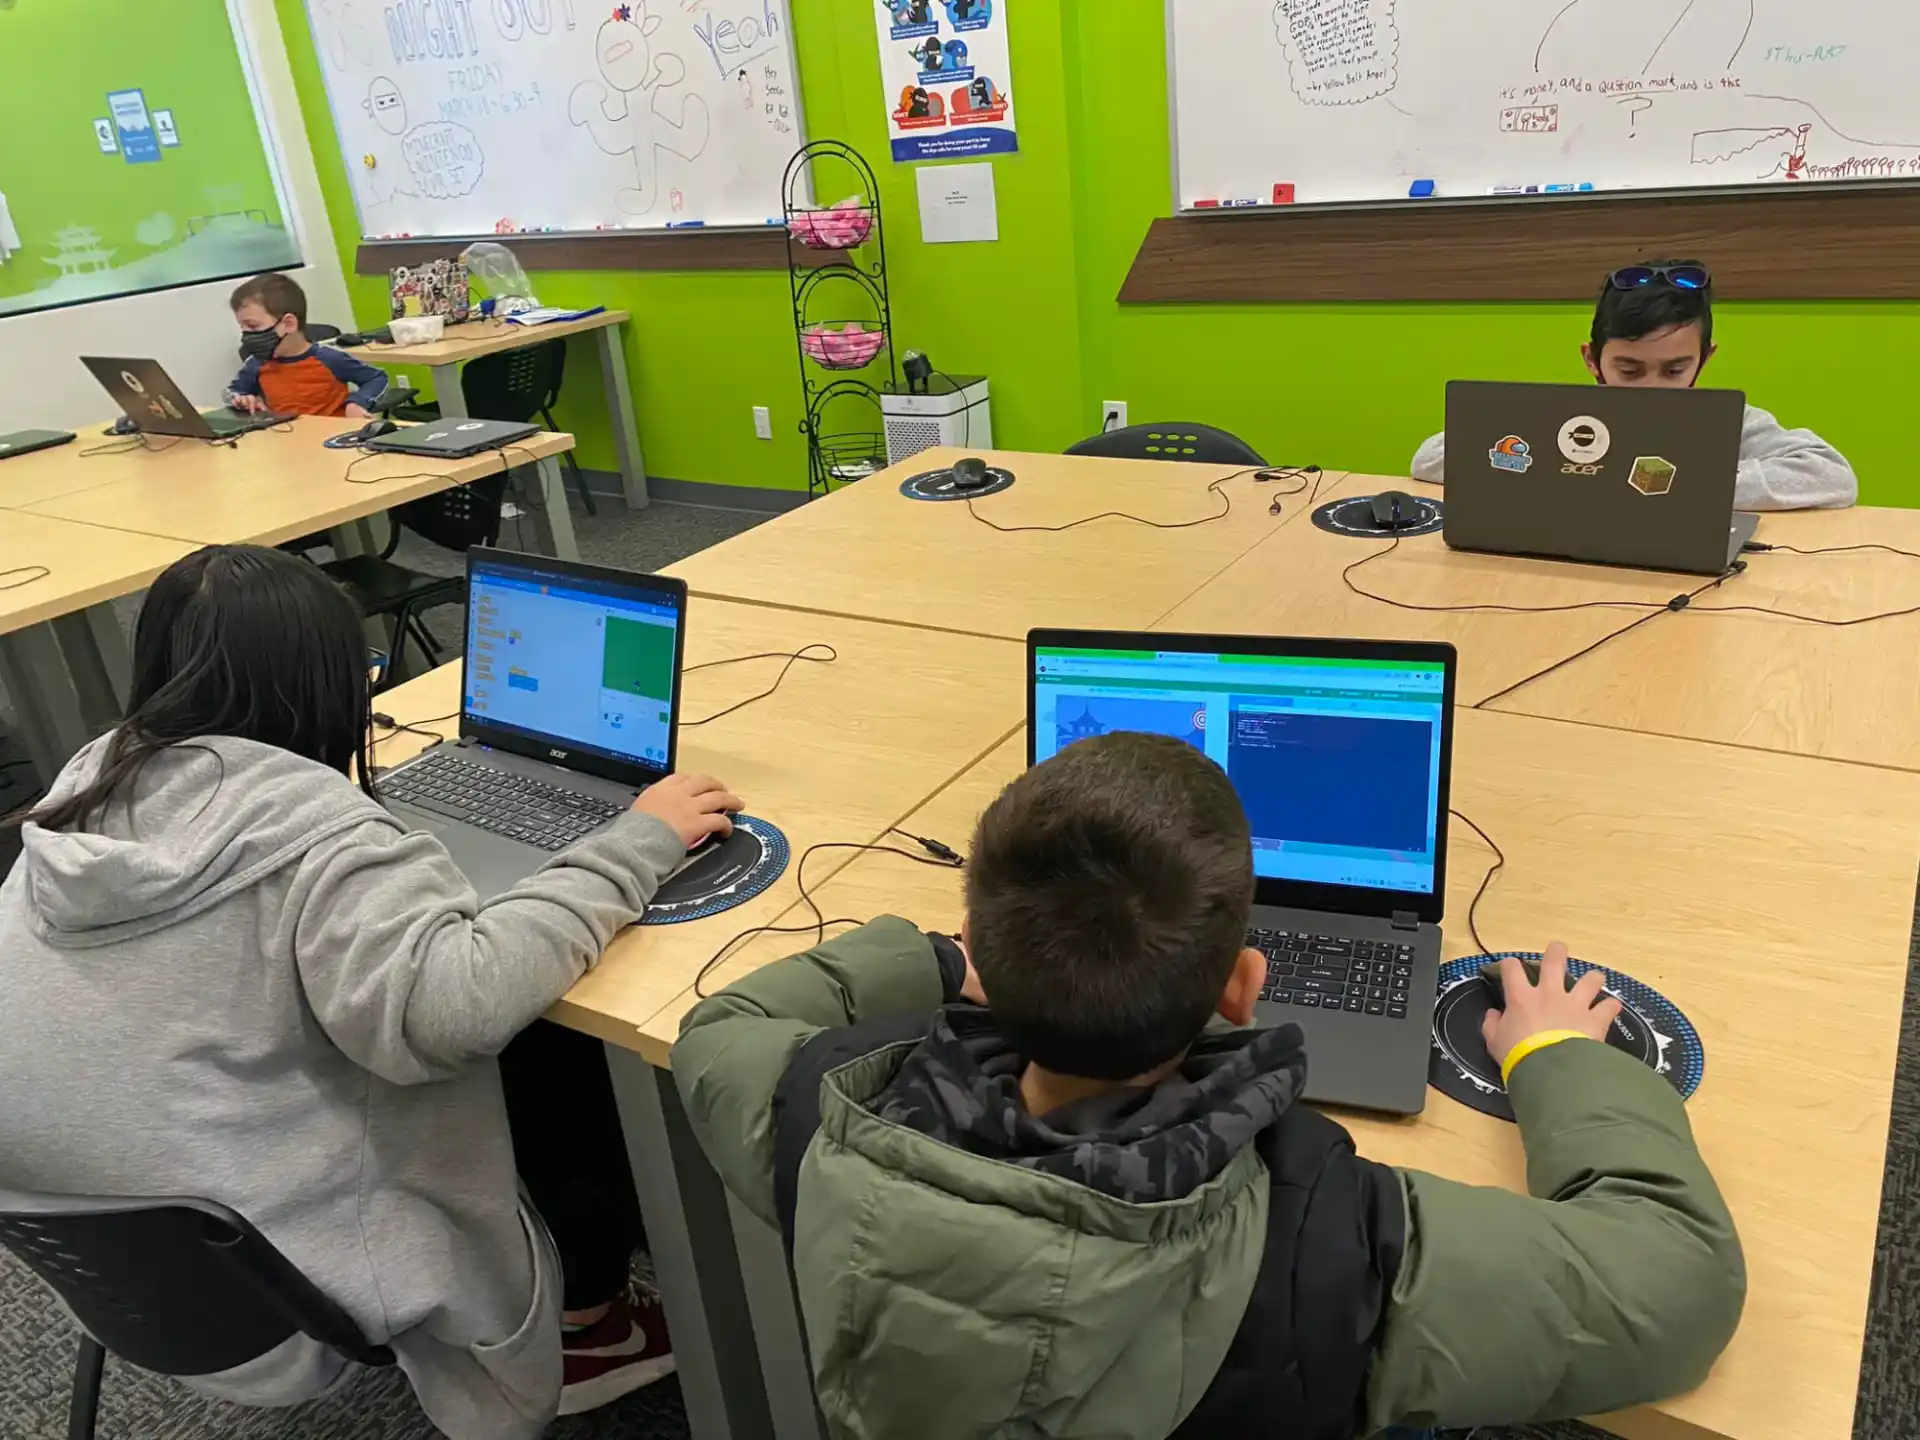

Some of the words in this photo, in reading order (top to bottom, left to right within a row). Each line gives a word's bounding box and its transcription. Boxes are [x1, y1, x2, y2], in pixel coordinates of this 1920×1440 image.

[384, 0, 478, 62] NIGHT
[693, 0, 779, 81] Yeah
[447, 60, 502, 93] FRIDAY
[1346, 72, 1362, 85] Belt
[1366, 68, 1387, 80] Angel
[1560, 77, 1583, 92] and
[1585, 82, 1593, 92] a
[1704, 78, 1714, 90] is
[1720, 74, 1741, 88] this
[1560, 462, 1604, 476] acer
[549, 748, 568, 760] acer
